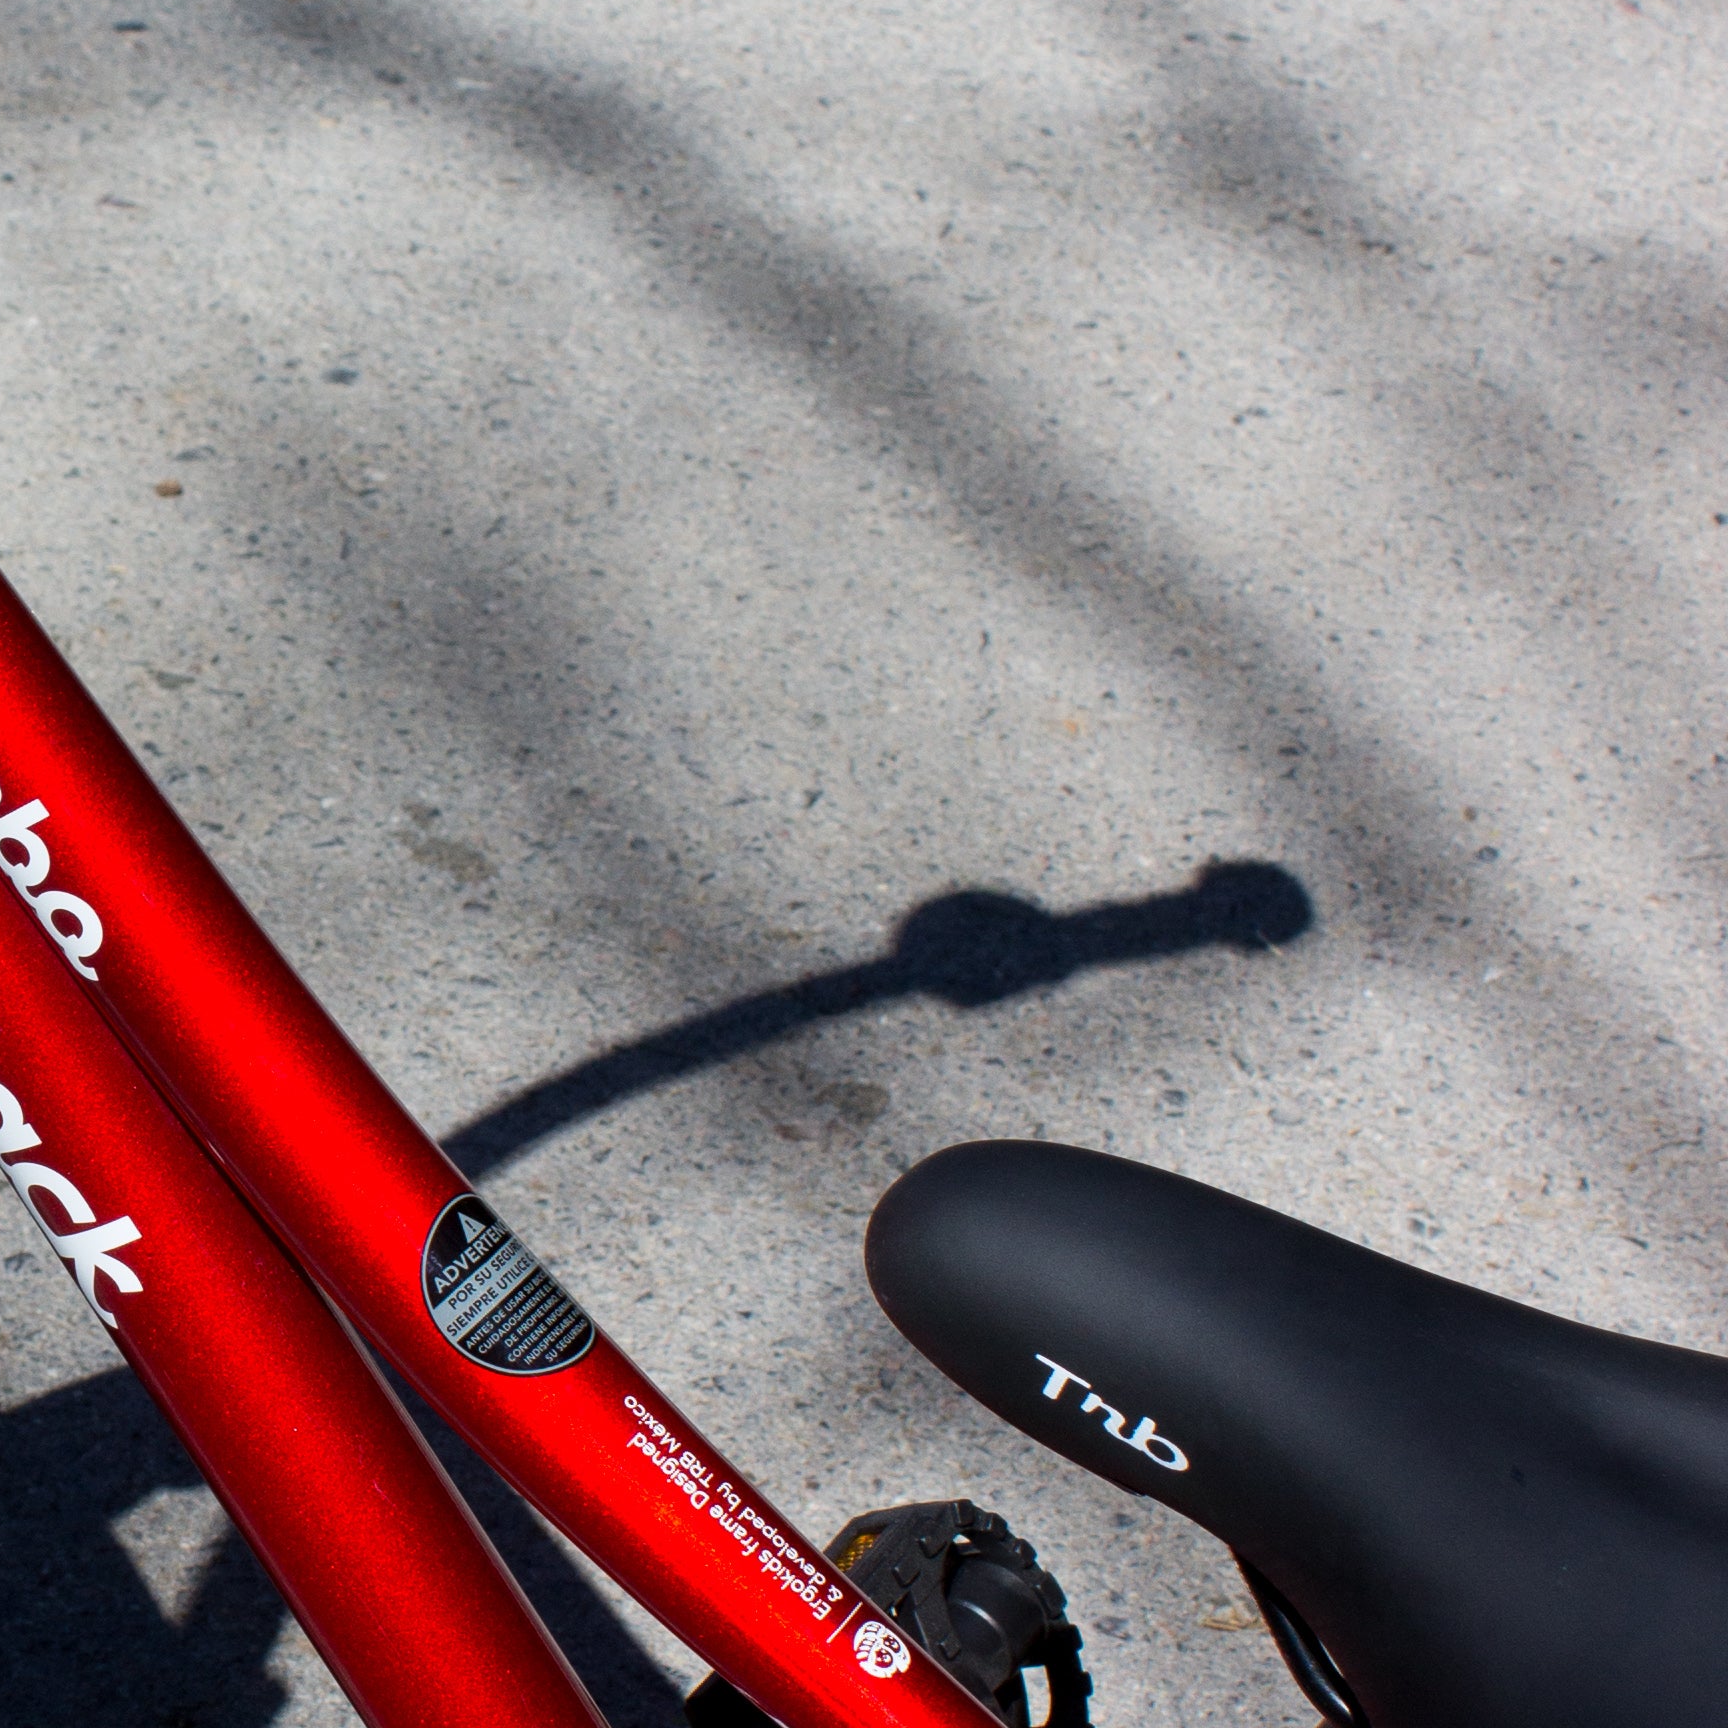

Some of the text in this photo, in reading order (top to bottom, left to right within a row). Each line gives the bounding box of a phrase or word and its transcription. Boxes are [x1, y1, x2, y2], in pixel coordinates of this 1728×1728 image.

[447, 1287, 499, 1336] SIEMPRE
[496, 1257, 531, 1289] UTILICE
[448, 1283, 476, 1310] POR
[475, 1267, 492, 1285] SU
[467, 1321, 493, 1348] ANTES
[492, 1310, 506, 1323] DE
[505, 1291, 526, 1311] USAR
[479, 1290, 545, 1353] CUIDADOSAMENTE
[504, 1334, 518, 1347] DE
[508, 1323, 547, 1362] CONTIENE
[524, 1315, 574, 1364] INDISPENSABLE
[546, 1349, 557, 1362] SU
[624, 1396, 843, 1603] & developed by TRB México
[627, 1432, 833, 1620] Ergokids frame Designed
